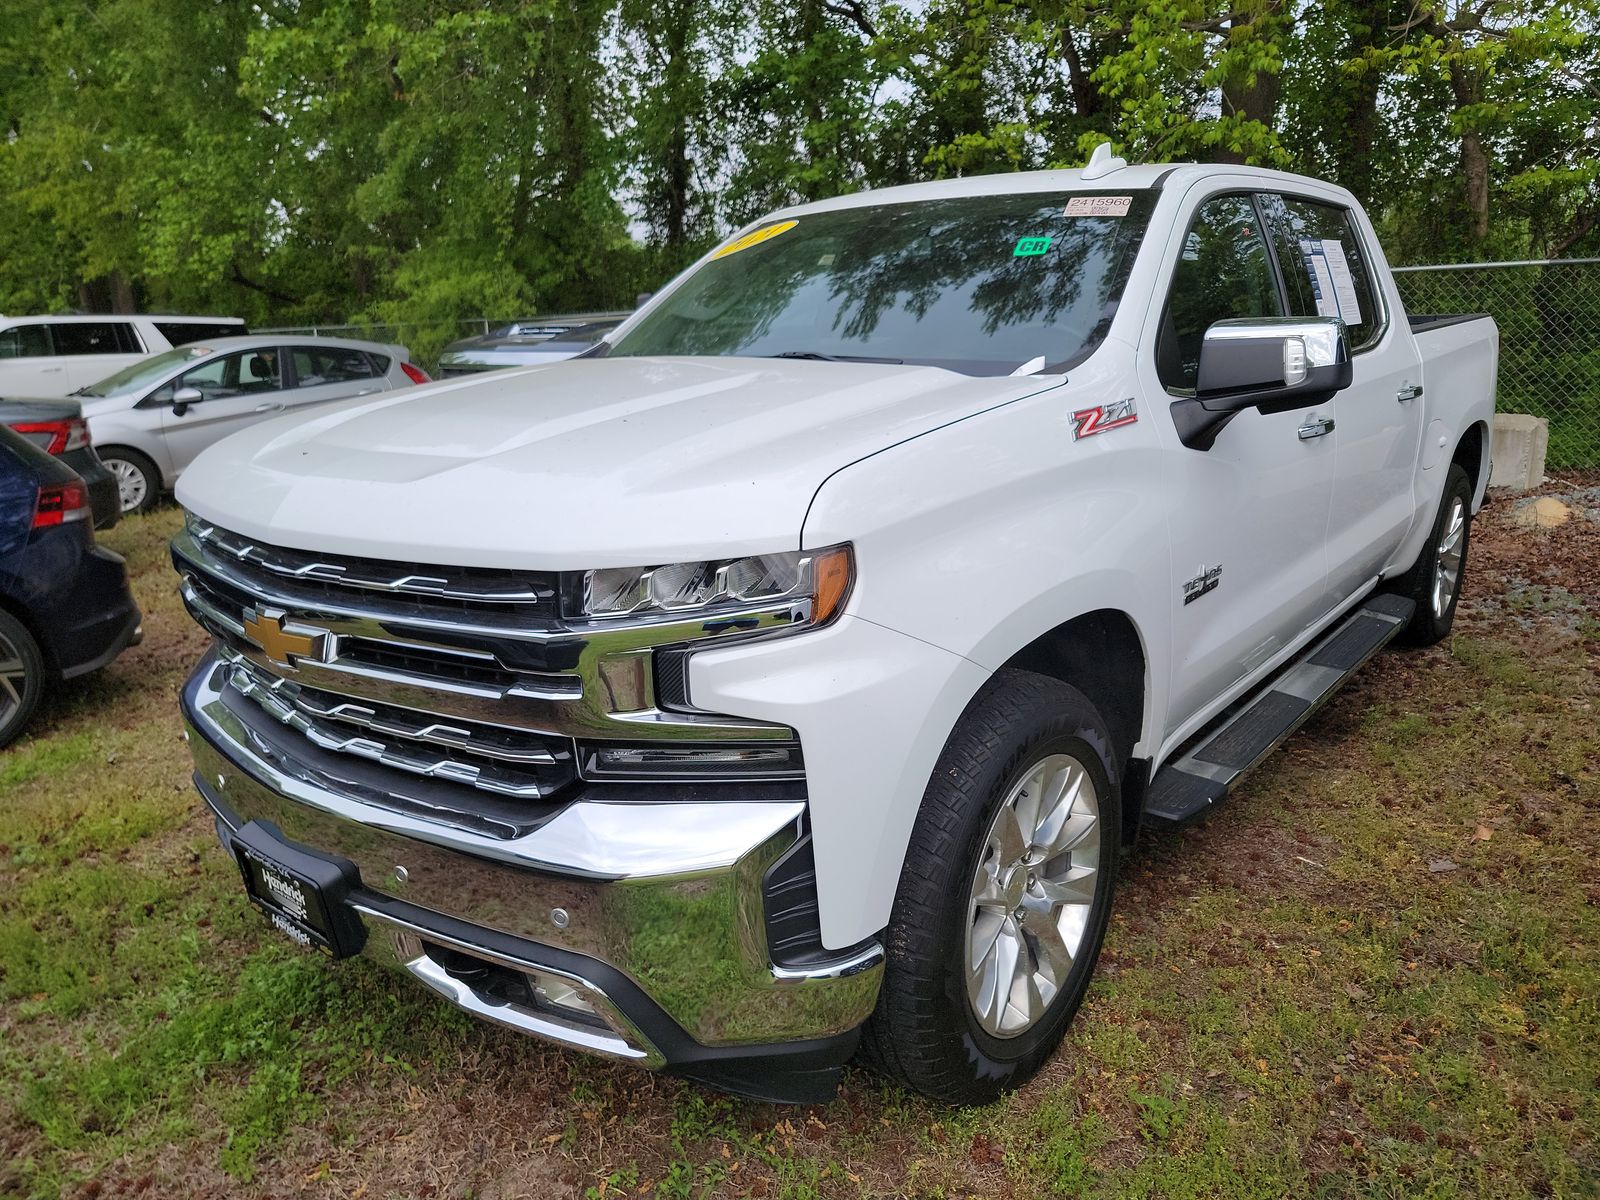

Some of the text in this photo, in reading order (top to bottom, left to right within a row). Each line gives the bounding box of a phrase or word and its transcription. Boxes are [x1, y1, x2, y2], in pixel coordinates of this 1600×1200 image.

[1071, 198, 1131, 207] 2415960
[1019, 240, 1046, 253] CR
[1067, 396, 1139, 442] Z71
[262, 868, 306, 906] Hendrick
[272, 913, 311, 945] Hendrick
